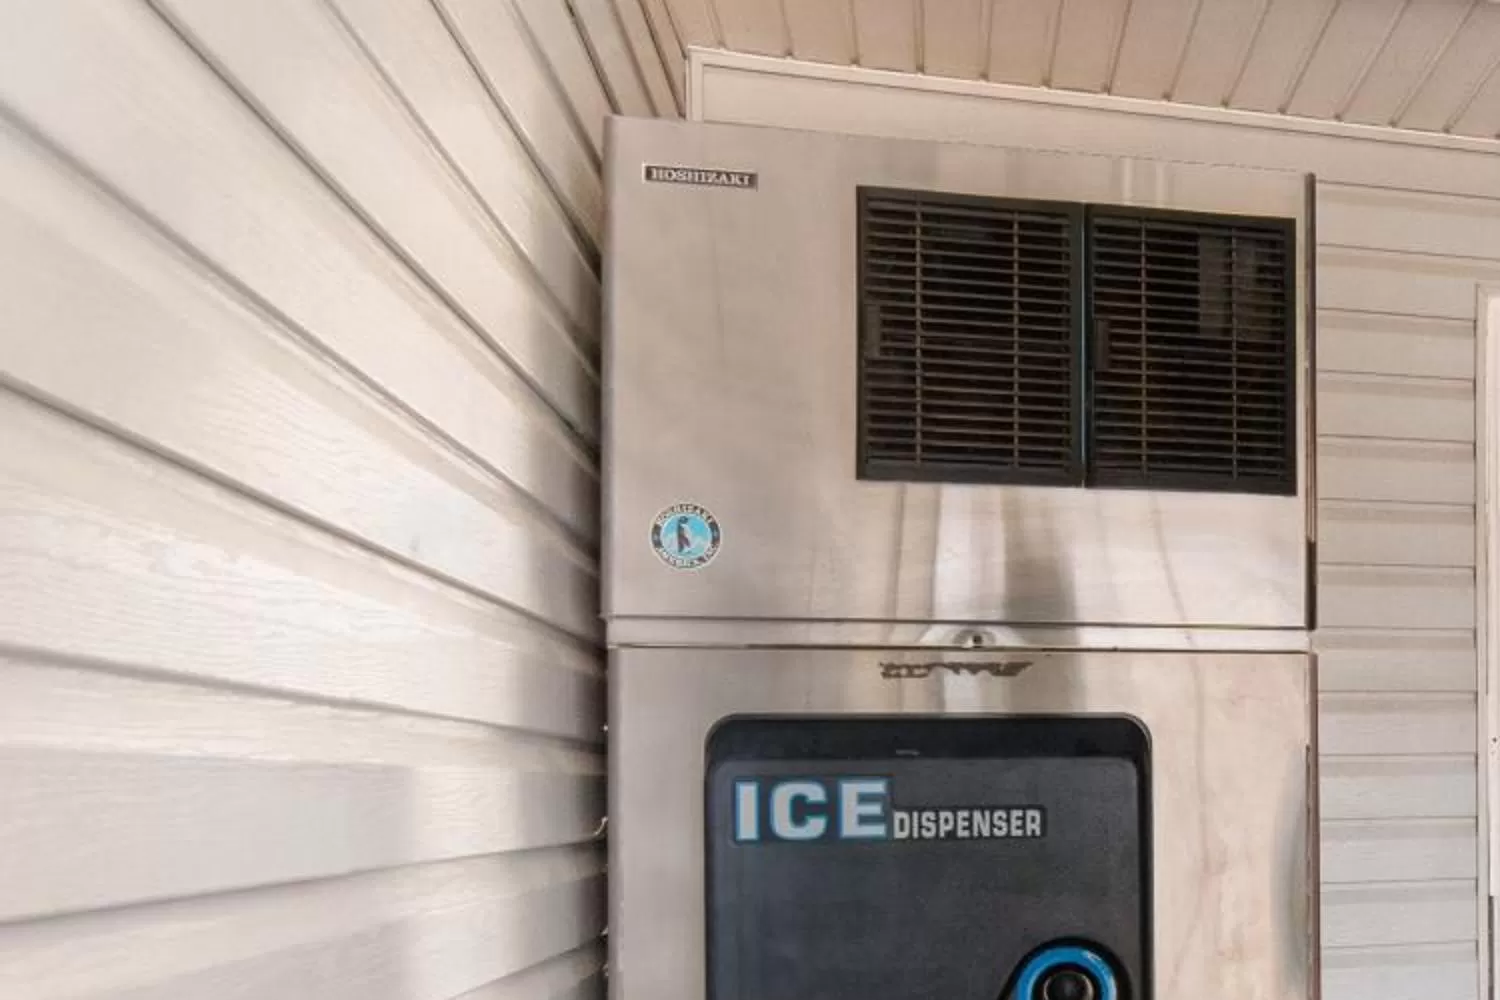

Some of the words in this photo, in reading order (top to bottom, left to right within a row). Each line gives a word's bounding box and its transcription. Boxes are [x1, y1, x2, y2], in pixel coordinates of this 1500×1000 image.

[651, 168, 750, 185] HOSHIZAKI
[735, 780, 888, 841] ICE
[893, 809, 1042, 839] DISPENSER
